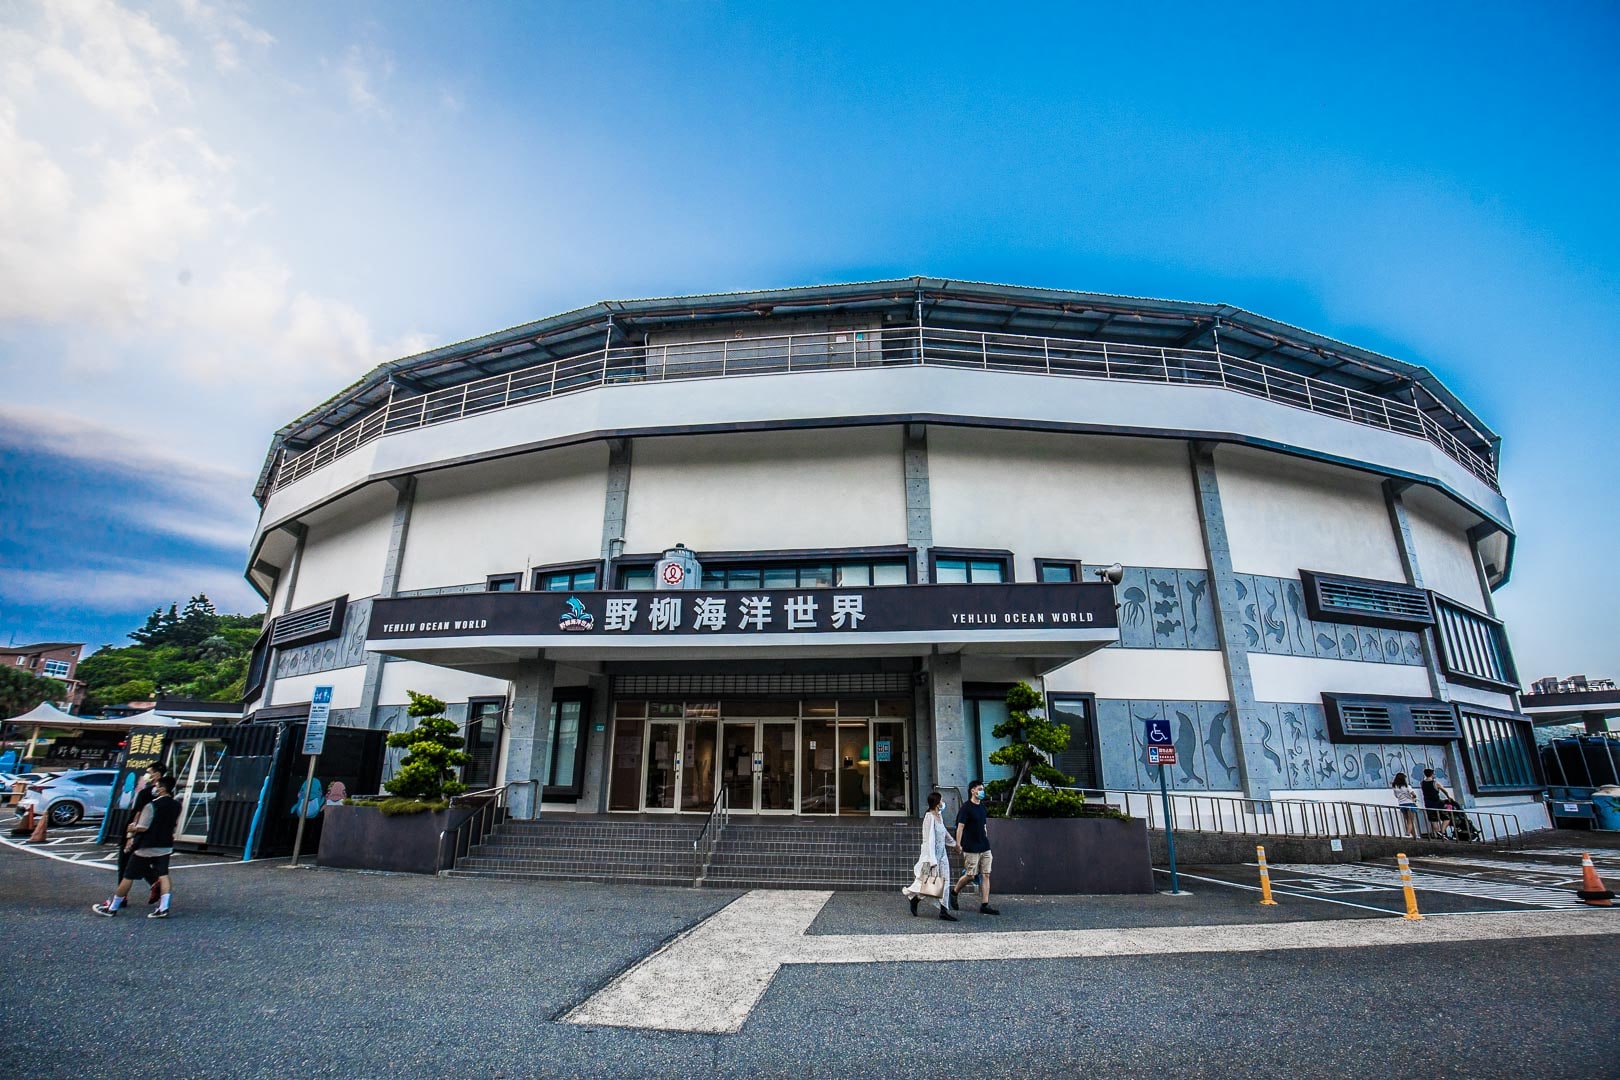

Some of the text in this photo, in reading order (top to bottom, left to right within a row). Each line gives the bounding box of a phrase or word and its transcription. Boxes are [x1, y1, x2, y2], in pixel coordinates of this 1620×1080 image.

[604, 594, 866, 631] 野柳海洋世界
[952, 612, 1094, 624] YEHLIU OCEAN WORLD
[383, 619, 487, 633] YEHLIU OCEAN WORLD
